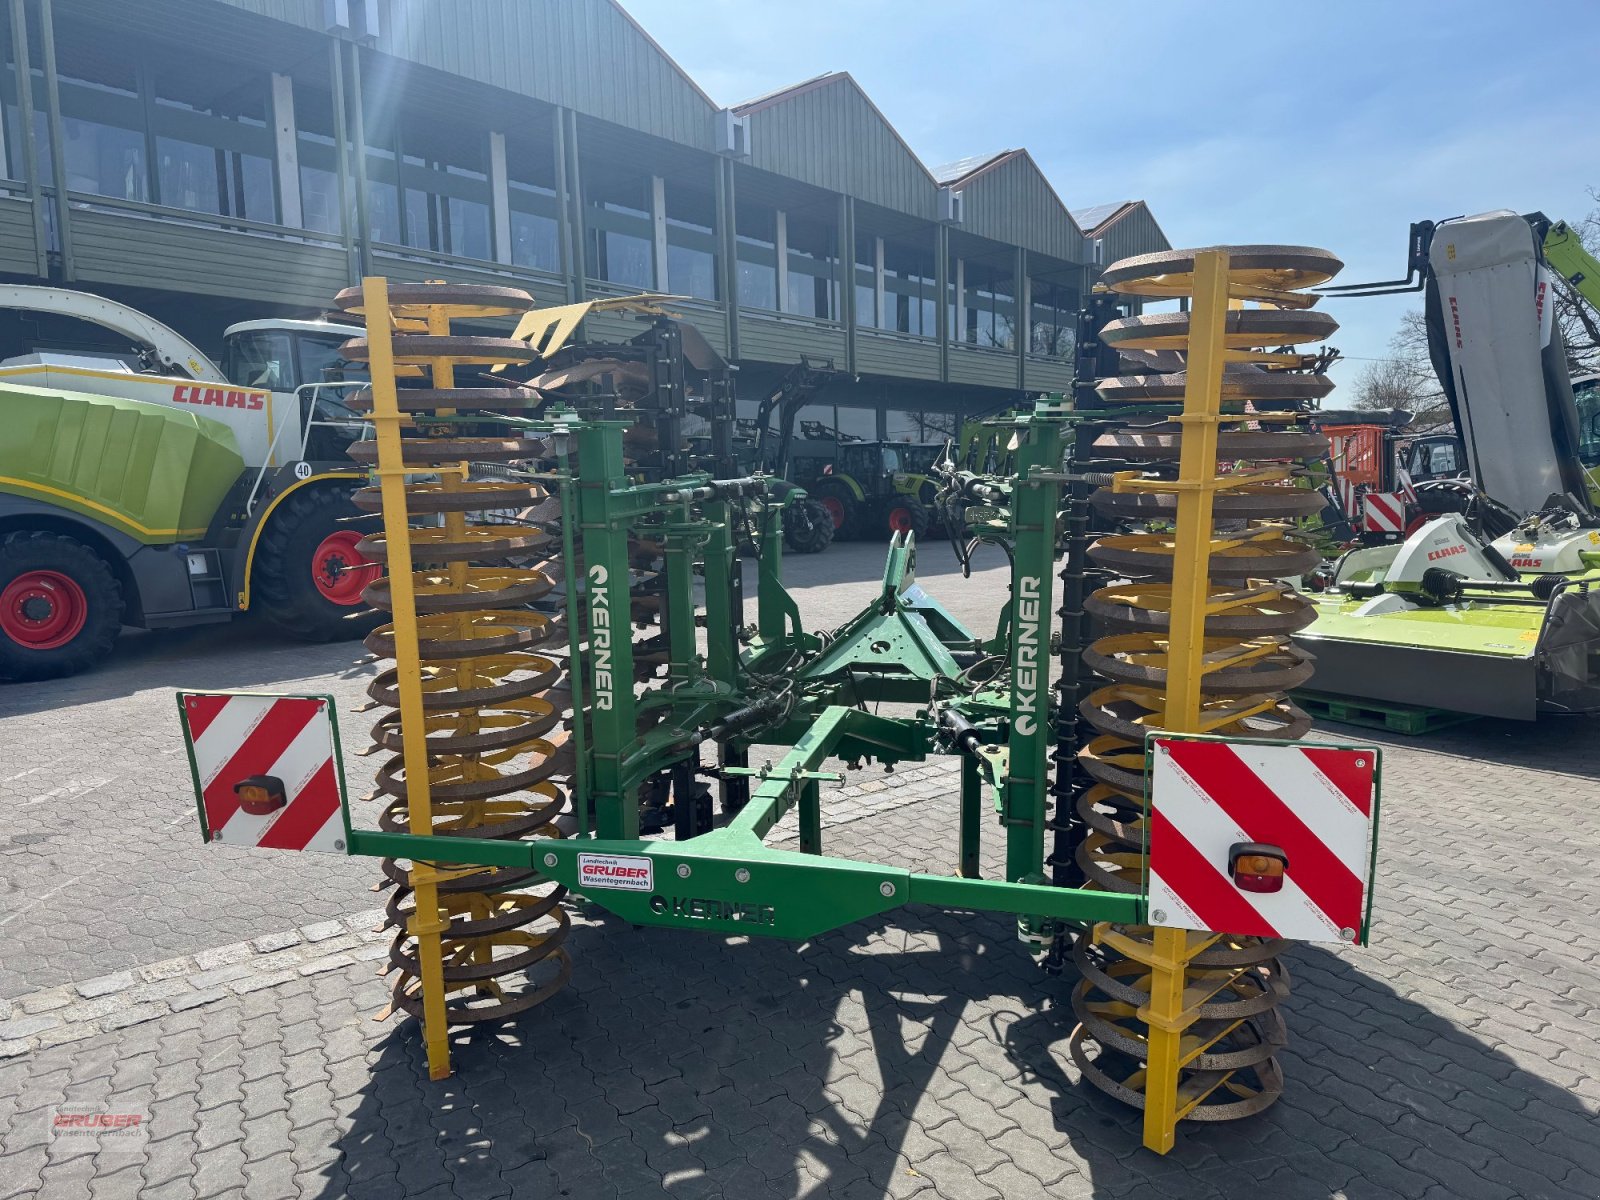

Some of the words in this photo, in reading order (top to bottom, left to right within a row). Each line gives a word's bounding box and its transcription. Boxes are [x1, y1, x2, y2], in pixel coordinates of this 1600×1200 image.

[1448, 296, 1463, 349] CLAAS
[172, 385, 265, 410] CLAAS
[297, 465, 309, 476] 40
[1427, 544, 1467, 561] CLAAS
[1507, 559, 1542, 567] AAS
[592, 587, 613, 711] KERNER
[1016, 576, 1041, 712] KERNER
[583, 858, 618, 866] Landtechnik
[583, 865, 648, 878] GRUBER
[583, 875, 649, 887] Wasentegernbach
[672, 896, 775, 926] KERNER
